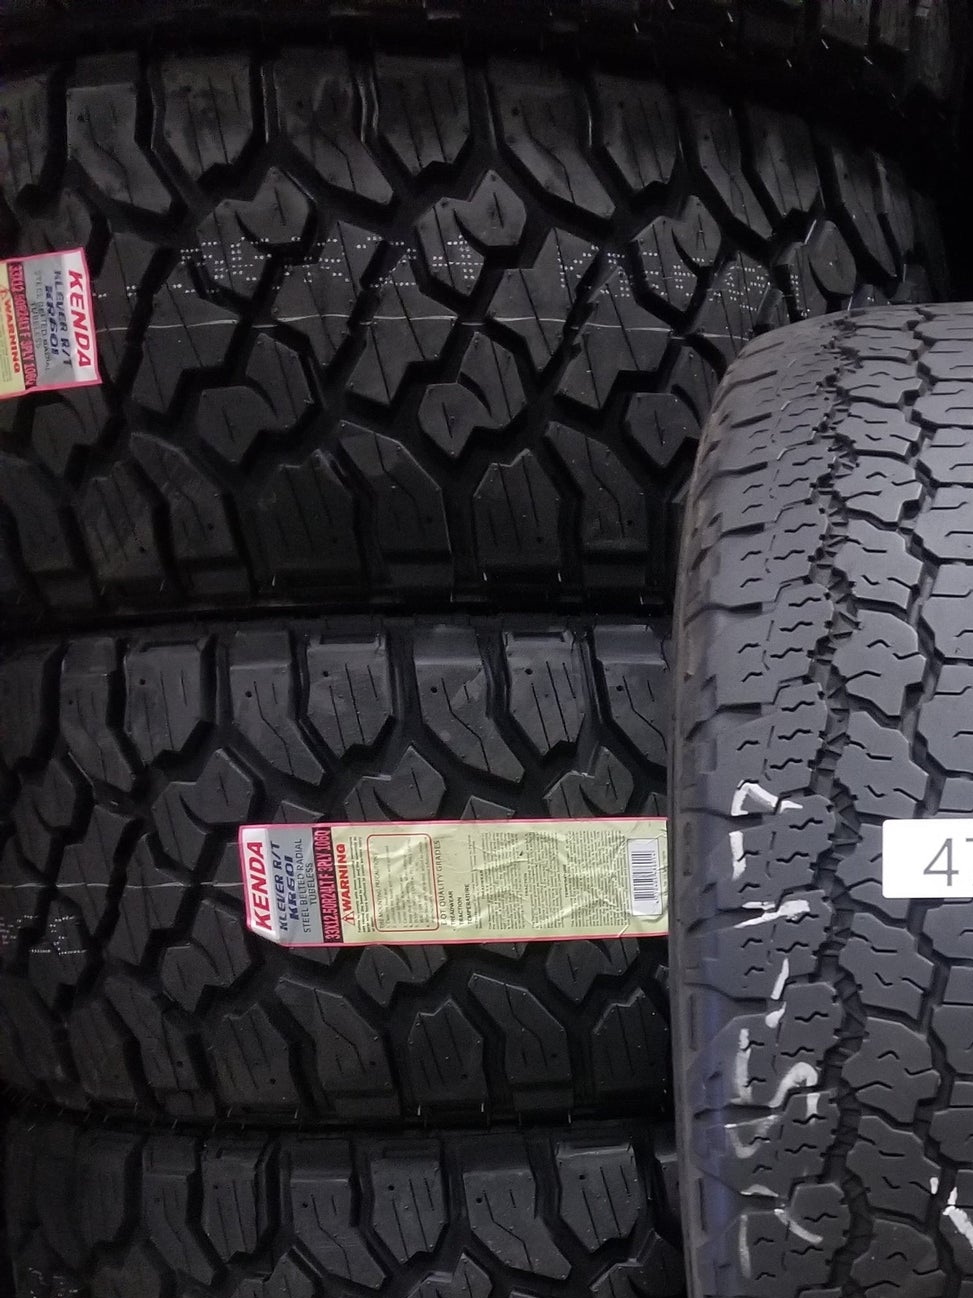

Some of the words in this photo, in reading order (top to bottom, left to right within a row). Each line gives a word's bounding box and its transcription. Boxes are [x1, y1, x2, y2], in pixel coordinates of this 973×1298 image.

[54, 271, 69, 331] KLEVER
[69, 270, 91, 367] KENDA
[4, 299, 22, 374] WARNING
[61, 338, 72, 369] R/T
[271, 840, 283, 870] R/T
[295, 839, 305, 870] RADIAL
[434, 840, 443, 871] GRADES
[246, 841, 272, 930] KENDA
[298, 873, 309, 906] BELTED
[306, 863, 317, 906] TUBELESS
[335, 844, 352, 911] WARNING
[437, 873, 446, 907] QUALITY
[274, 875, 288, 930] KLEVER
[301, 909, 311, 933] STEEL
